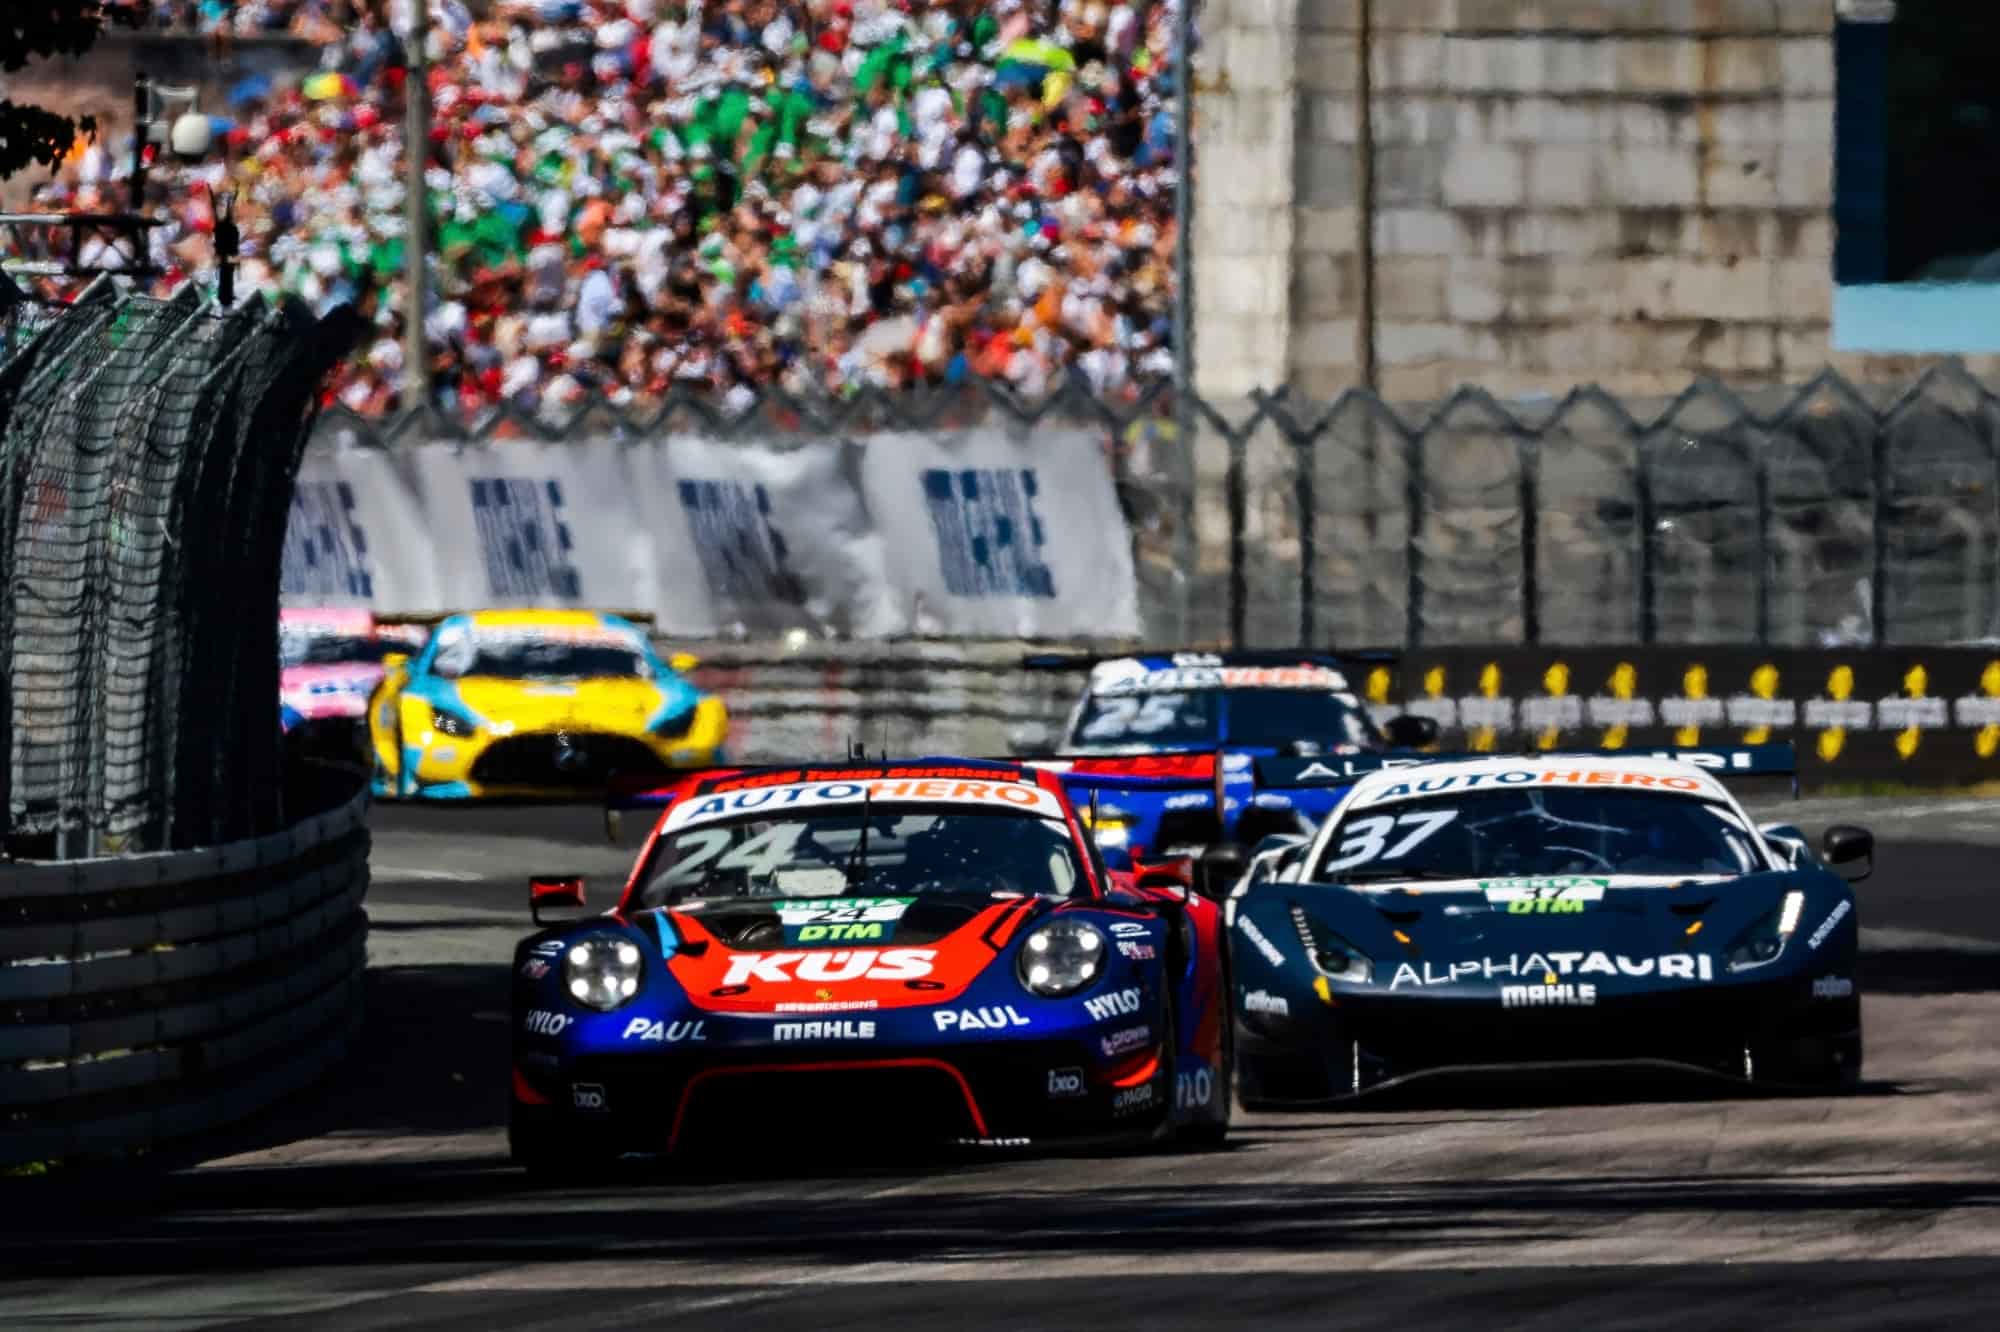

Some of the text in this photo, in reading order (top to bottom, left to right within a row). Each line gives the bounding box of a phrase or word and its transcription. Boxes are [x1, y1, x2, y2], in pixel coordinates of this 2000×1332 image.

[1082, 693, 1186, 739] 25
[686, 781, 1042, 820] AUTOHERO
[1376, 770, 1701, 801] AUTOHERO
[650, 822, 810, 889] 24
[1325, 809, 1459, 874] 37
[1507, 896, 1585, 914] DTM
[797, 922, 883, 942] DTM
[721, 948, 940, 986] KÜS
[1389, 951, 1714, 991] ALPHATAURI
[1083, 988, 1140, 1021] HYLO
[1502, 983, 1598, 1008] MAHLE
[621, 1016, 708, 1042] PAUL
[772, 1020, 877, 1041] MAHLE
[931, 1004, 1031, 1032] PAUL
